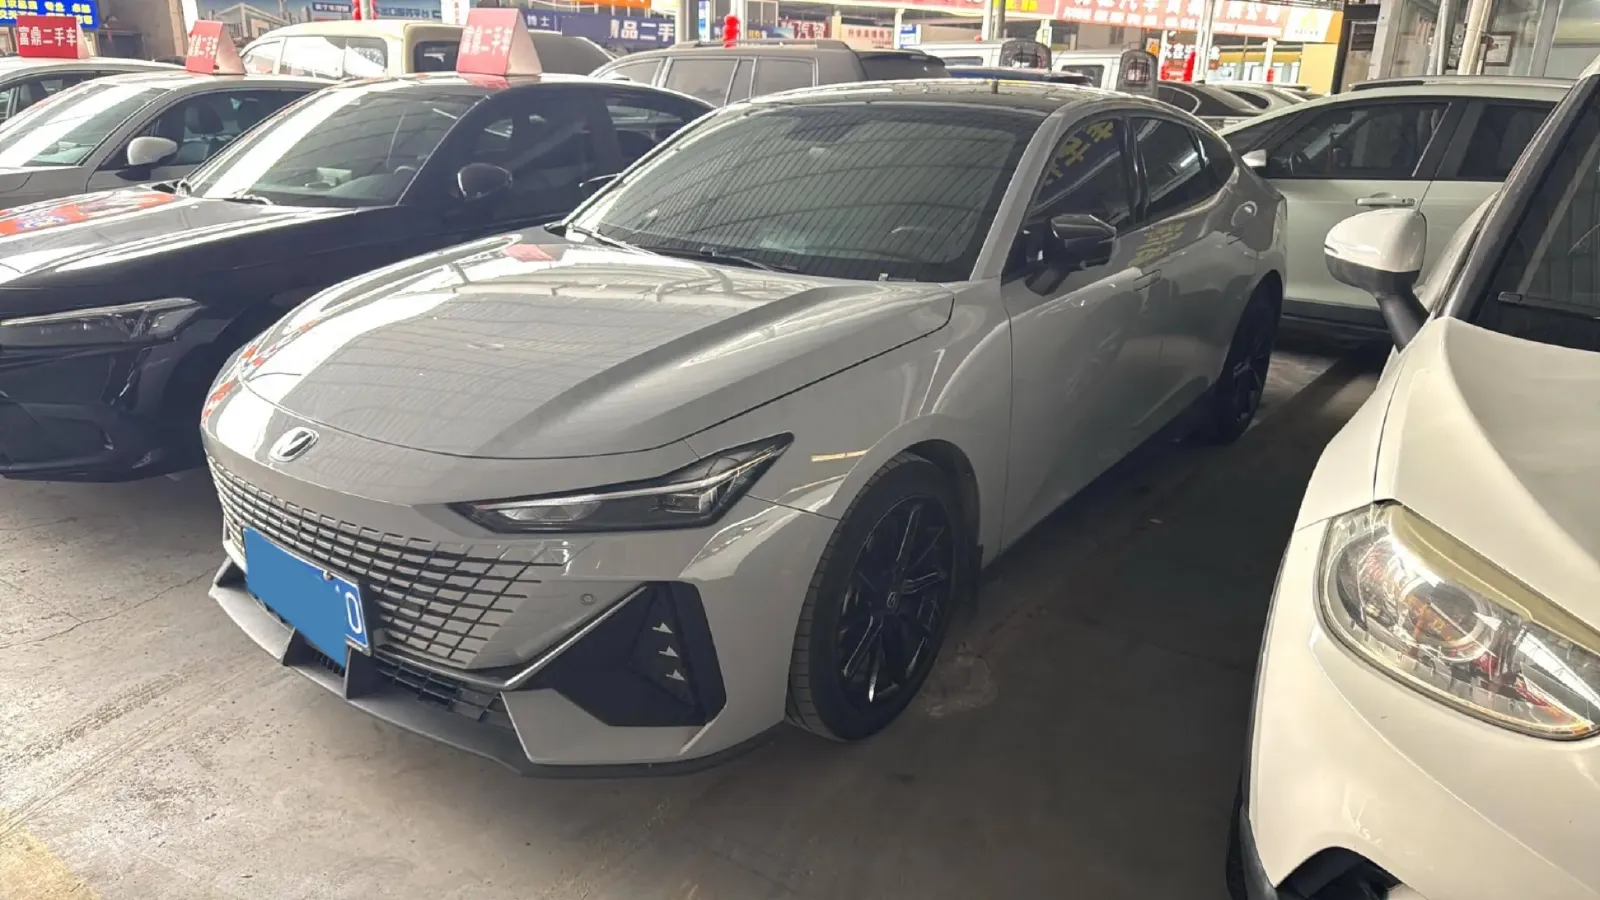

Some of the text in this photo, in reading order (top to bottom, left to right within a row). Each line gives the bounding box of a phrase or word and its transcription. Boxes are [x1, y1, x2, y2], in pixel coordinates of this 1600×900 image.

[18, 26, 77, 47] 富鼎二手车
